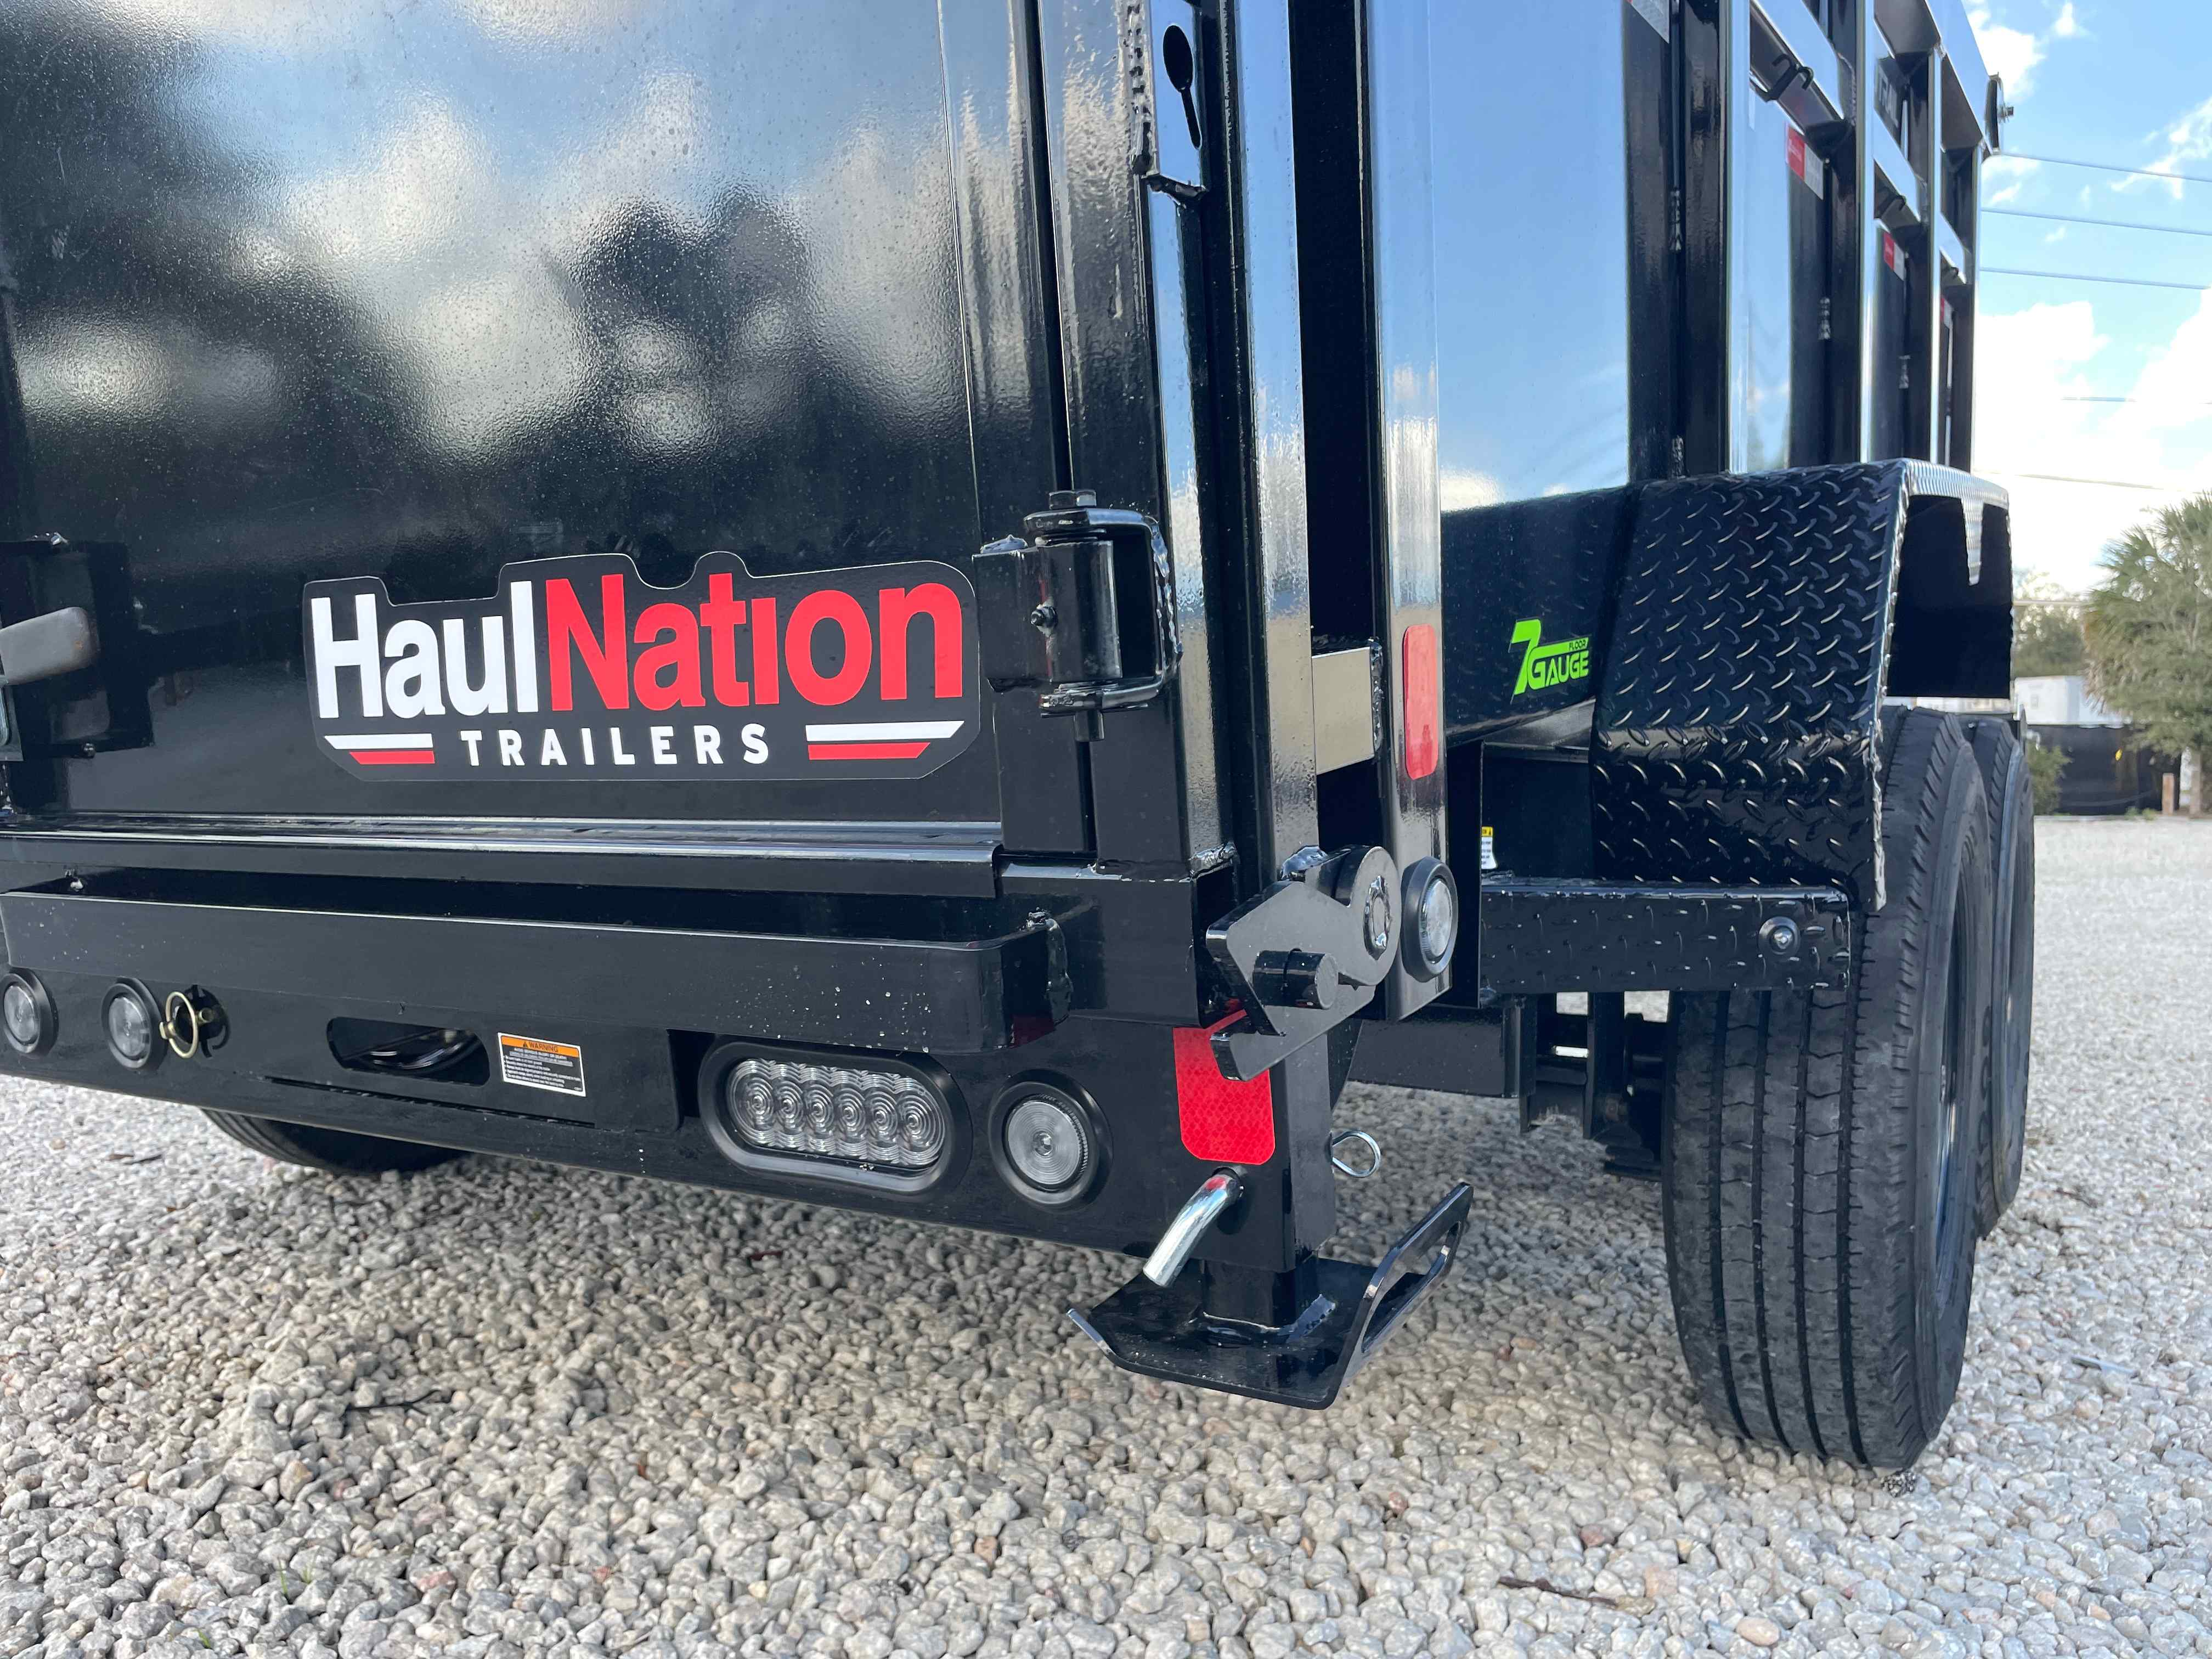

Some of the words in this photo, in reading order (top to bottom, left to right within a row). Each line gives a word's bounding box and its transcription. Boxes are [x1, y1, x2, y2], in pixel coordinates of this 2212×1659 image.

[1511, 619, 1541, 695] 7
[1527, 648, 1589, 690] GAUGE
[1569, 640, 1586, 650] FLOOR
[460, 724, 768, 766] TRAILERS
[529, 1042, 558, 1052] WARNING
